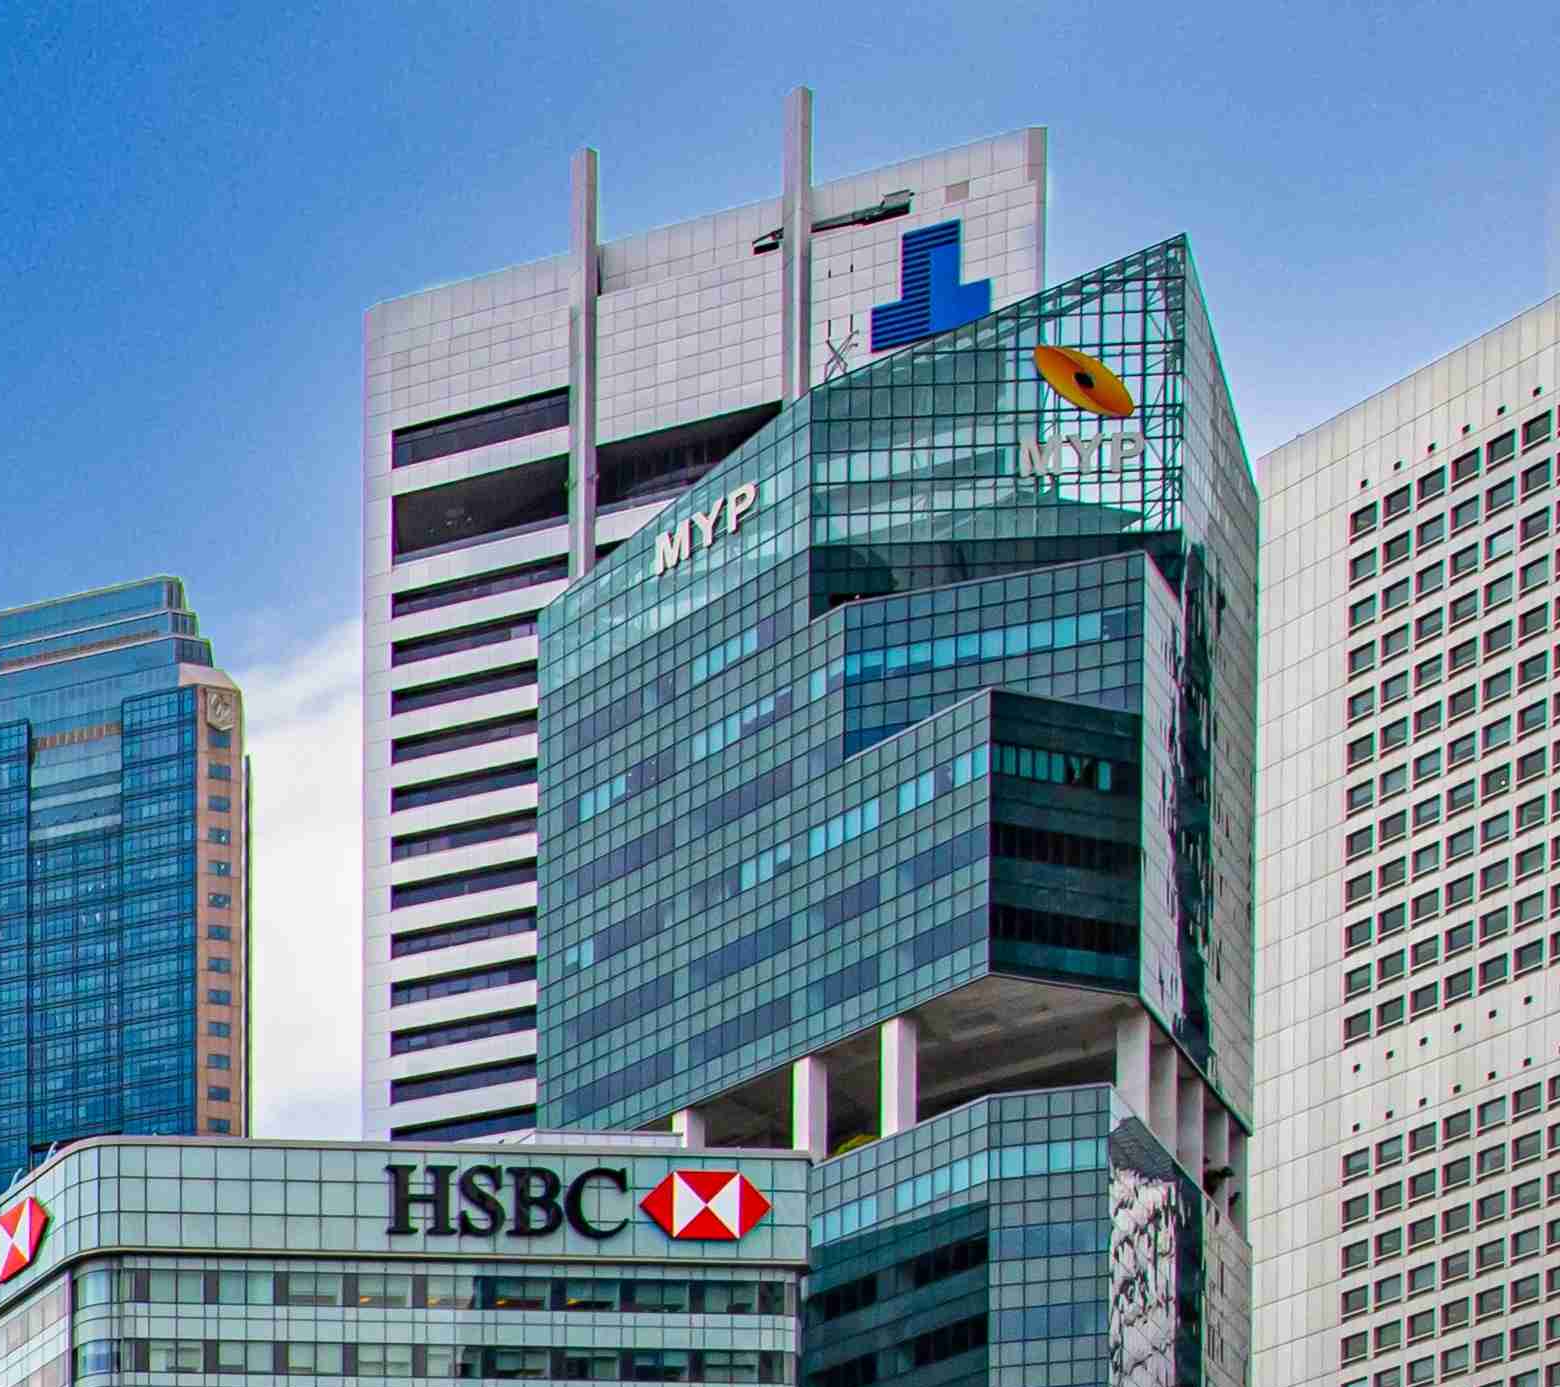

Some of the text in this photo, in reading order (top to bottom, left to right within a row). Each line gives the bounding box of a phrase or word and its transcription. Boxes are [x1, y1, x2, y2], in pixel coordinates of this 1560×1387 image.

[1019, 431, 1145, 477] MYP
[655, 482, 757, 576] MYP
[385, 1164, 630, 1240] HSBC
